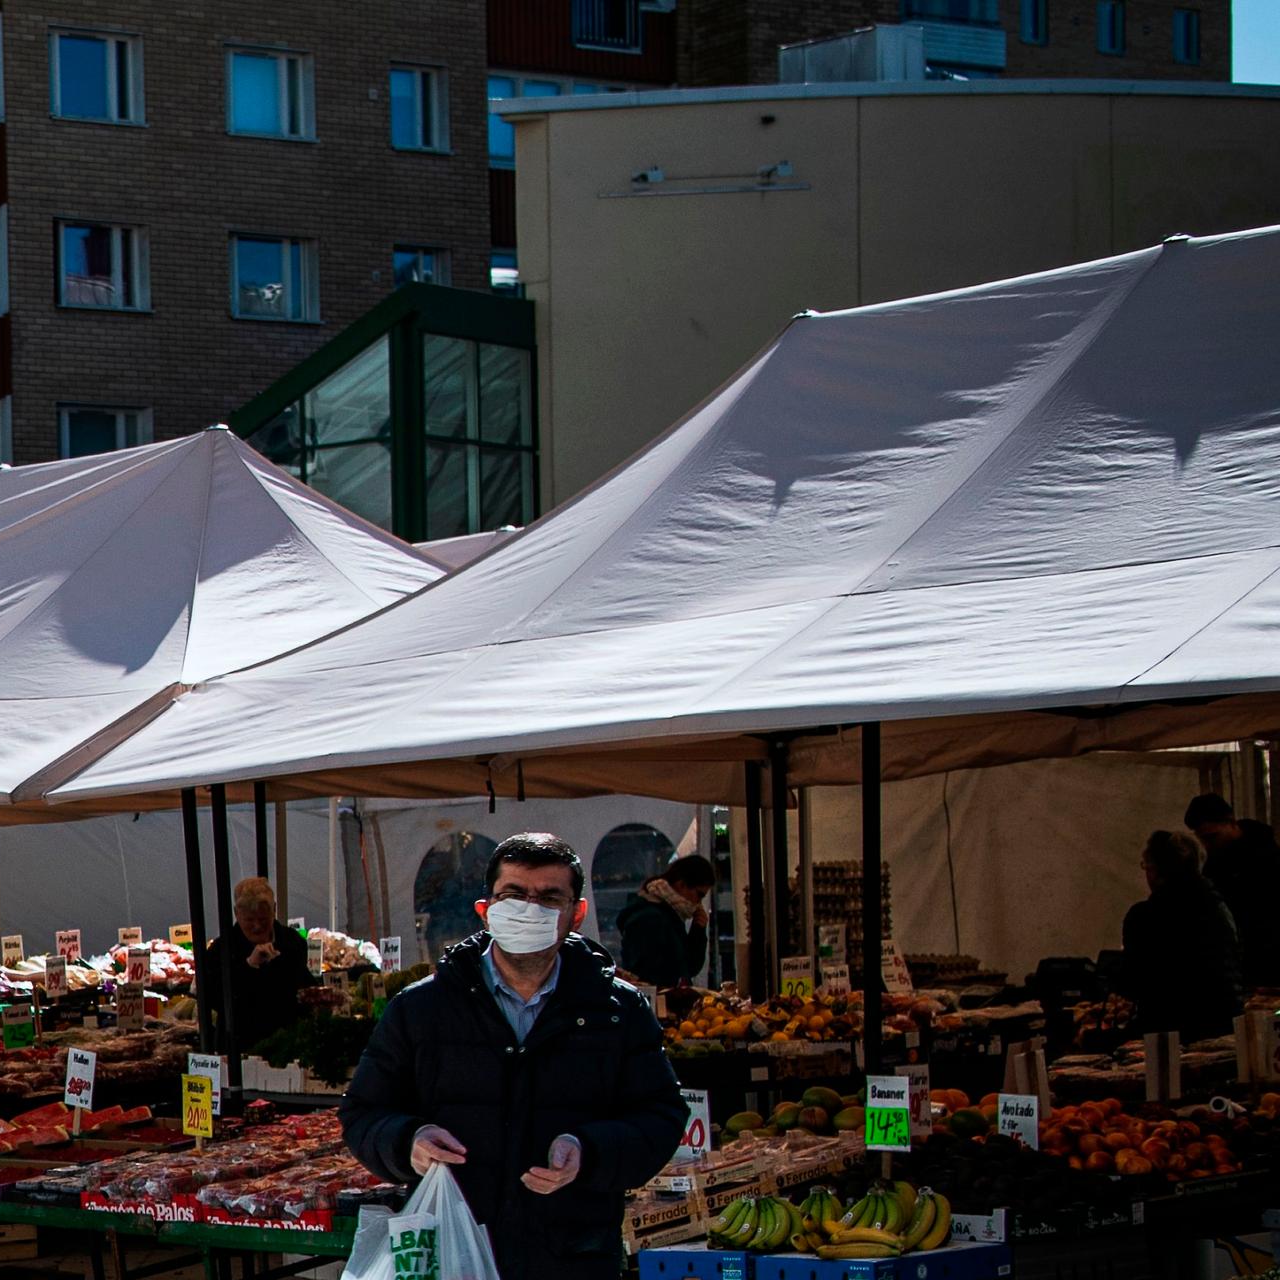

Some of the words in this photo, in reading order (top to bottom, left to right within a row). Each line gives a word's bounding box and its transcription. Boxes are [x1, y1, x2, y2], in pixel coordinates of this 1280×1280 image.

[73, 1053, 90, 1066] Hallon
[870, 1085, 905, 1100] Bananer
[1001, 1101, 1035, 1117] Avokado
[1007, 1120, 1018, 1131] för
[785, 1164, 829, 1186] Ferrada
[155, 1202, 194, 1222] Palos
[642, 1204, 689, 1226] Ferrada
